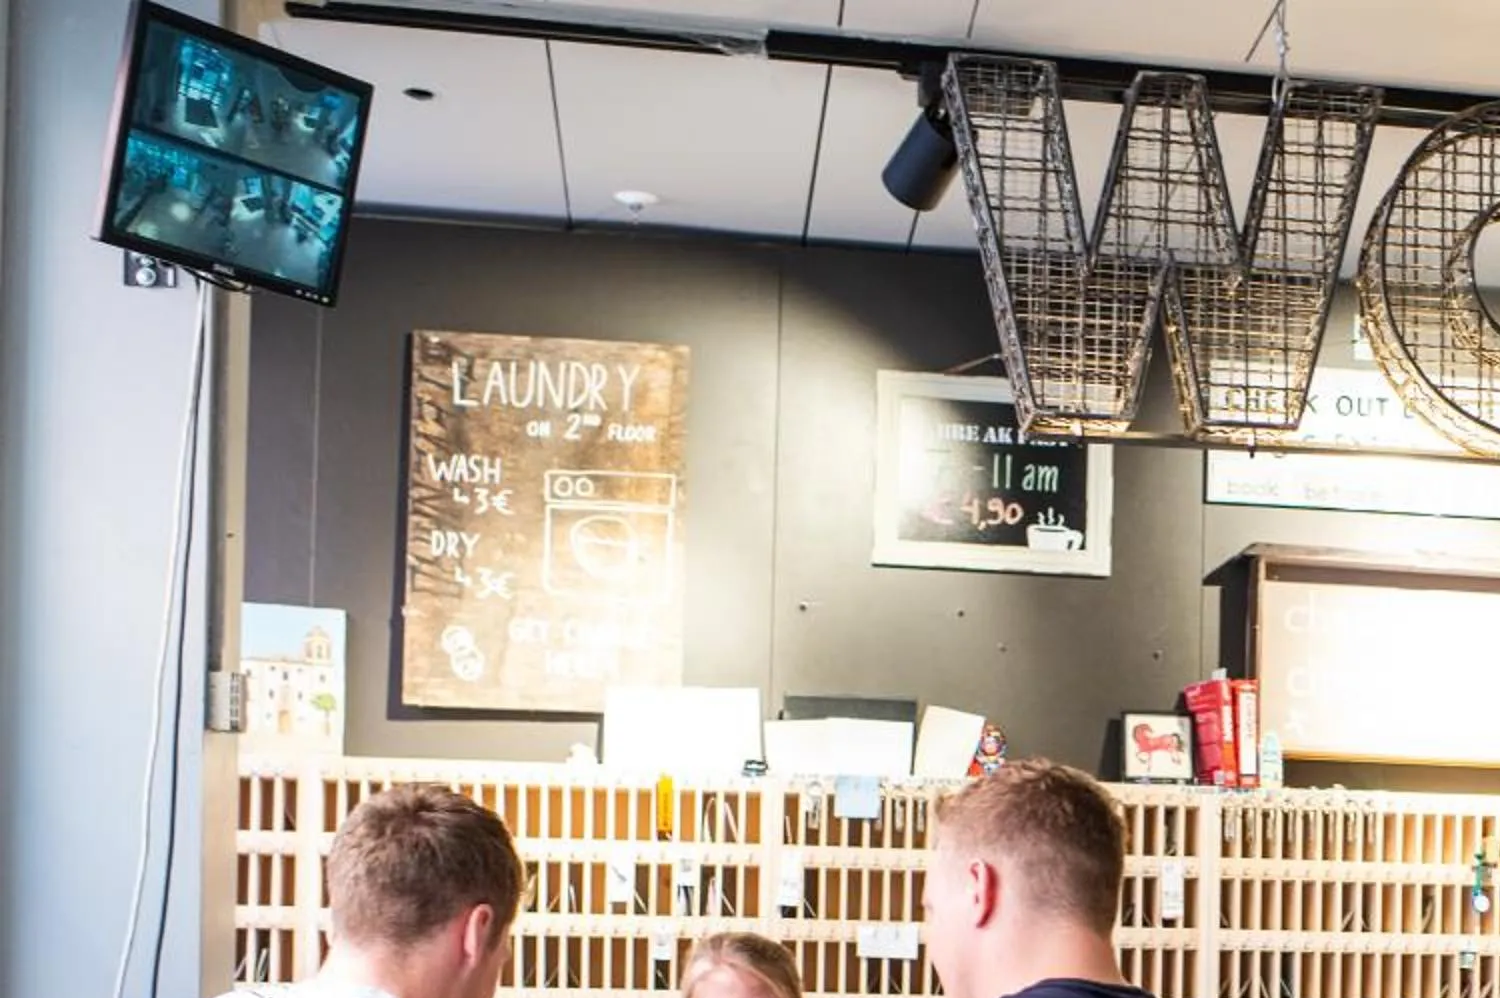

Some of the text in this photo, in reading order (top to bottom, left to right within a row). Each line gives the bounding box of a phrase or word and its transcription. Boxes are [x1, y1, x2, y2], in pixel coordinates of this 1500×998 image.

[451, 360, 641, 411] LAUNDRY
[1225, 389, 1319, 414] CHEK
[1335, 394, 1389, 417] OUT
[526, 420, 550, 438] ON
[607, 423, 657, 443] FLOOR
[427, 453, 502, 484] WASH
[1021, 463, 1060, 493] am
[430, 530, 481, 558] DRY
